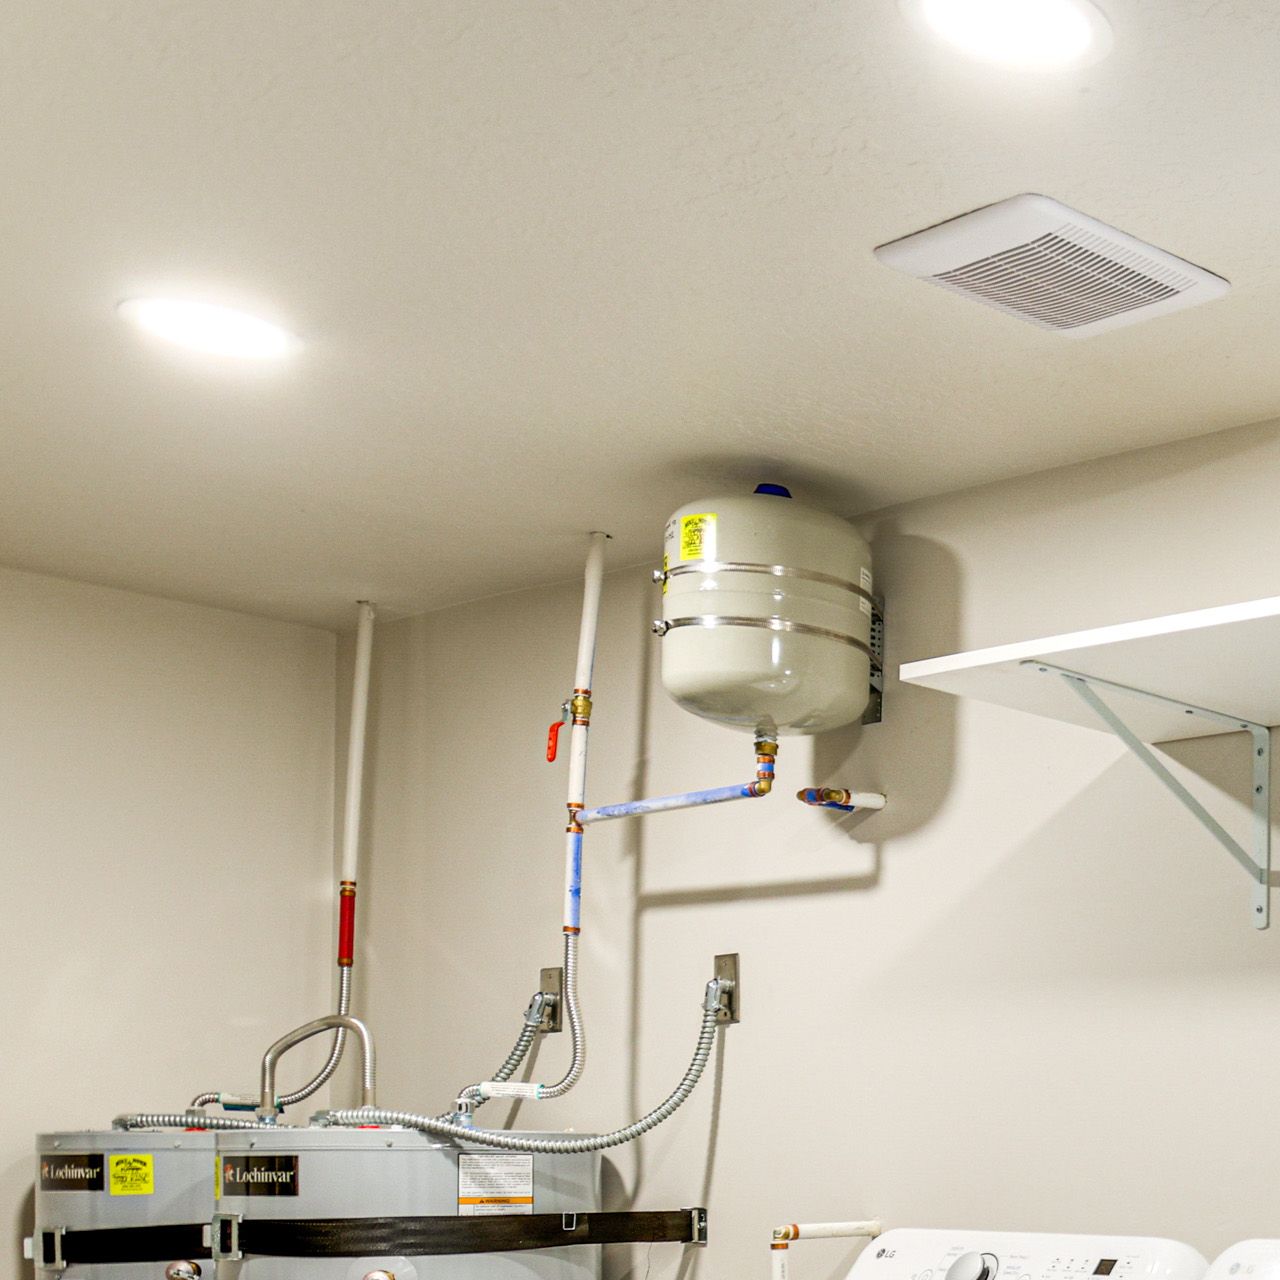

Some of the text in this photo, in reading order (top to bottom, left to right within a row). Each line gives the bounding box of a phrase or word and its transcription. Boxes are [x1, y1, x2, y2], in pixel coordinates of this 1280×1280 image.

[50, 1163, 101, 1180] Lochinvar
[235, 1164, 296, 1184] Lochinvar
[885, 1249, 896, 1258] LG
